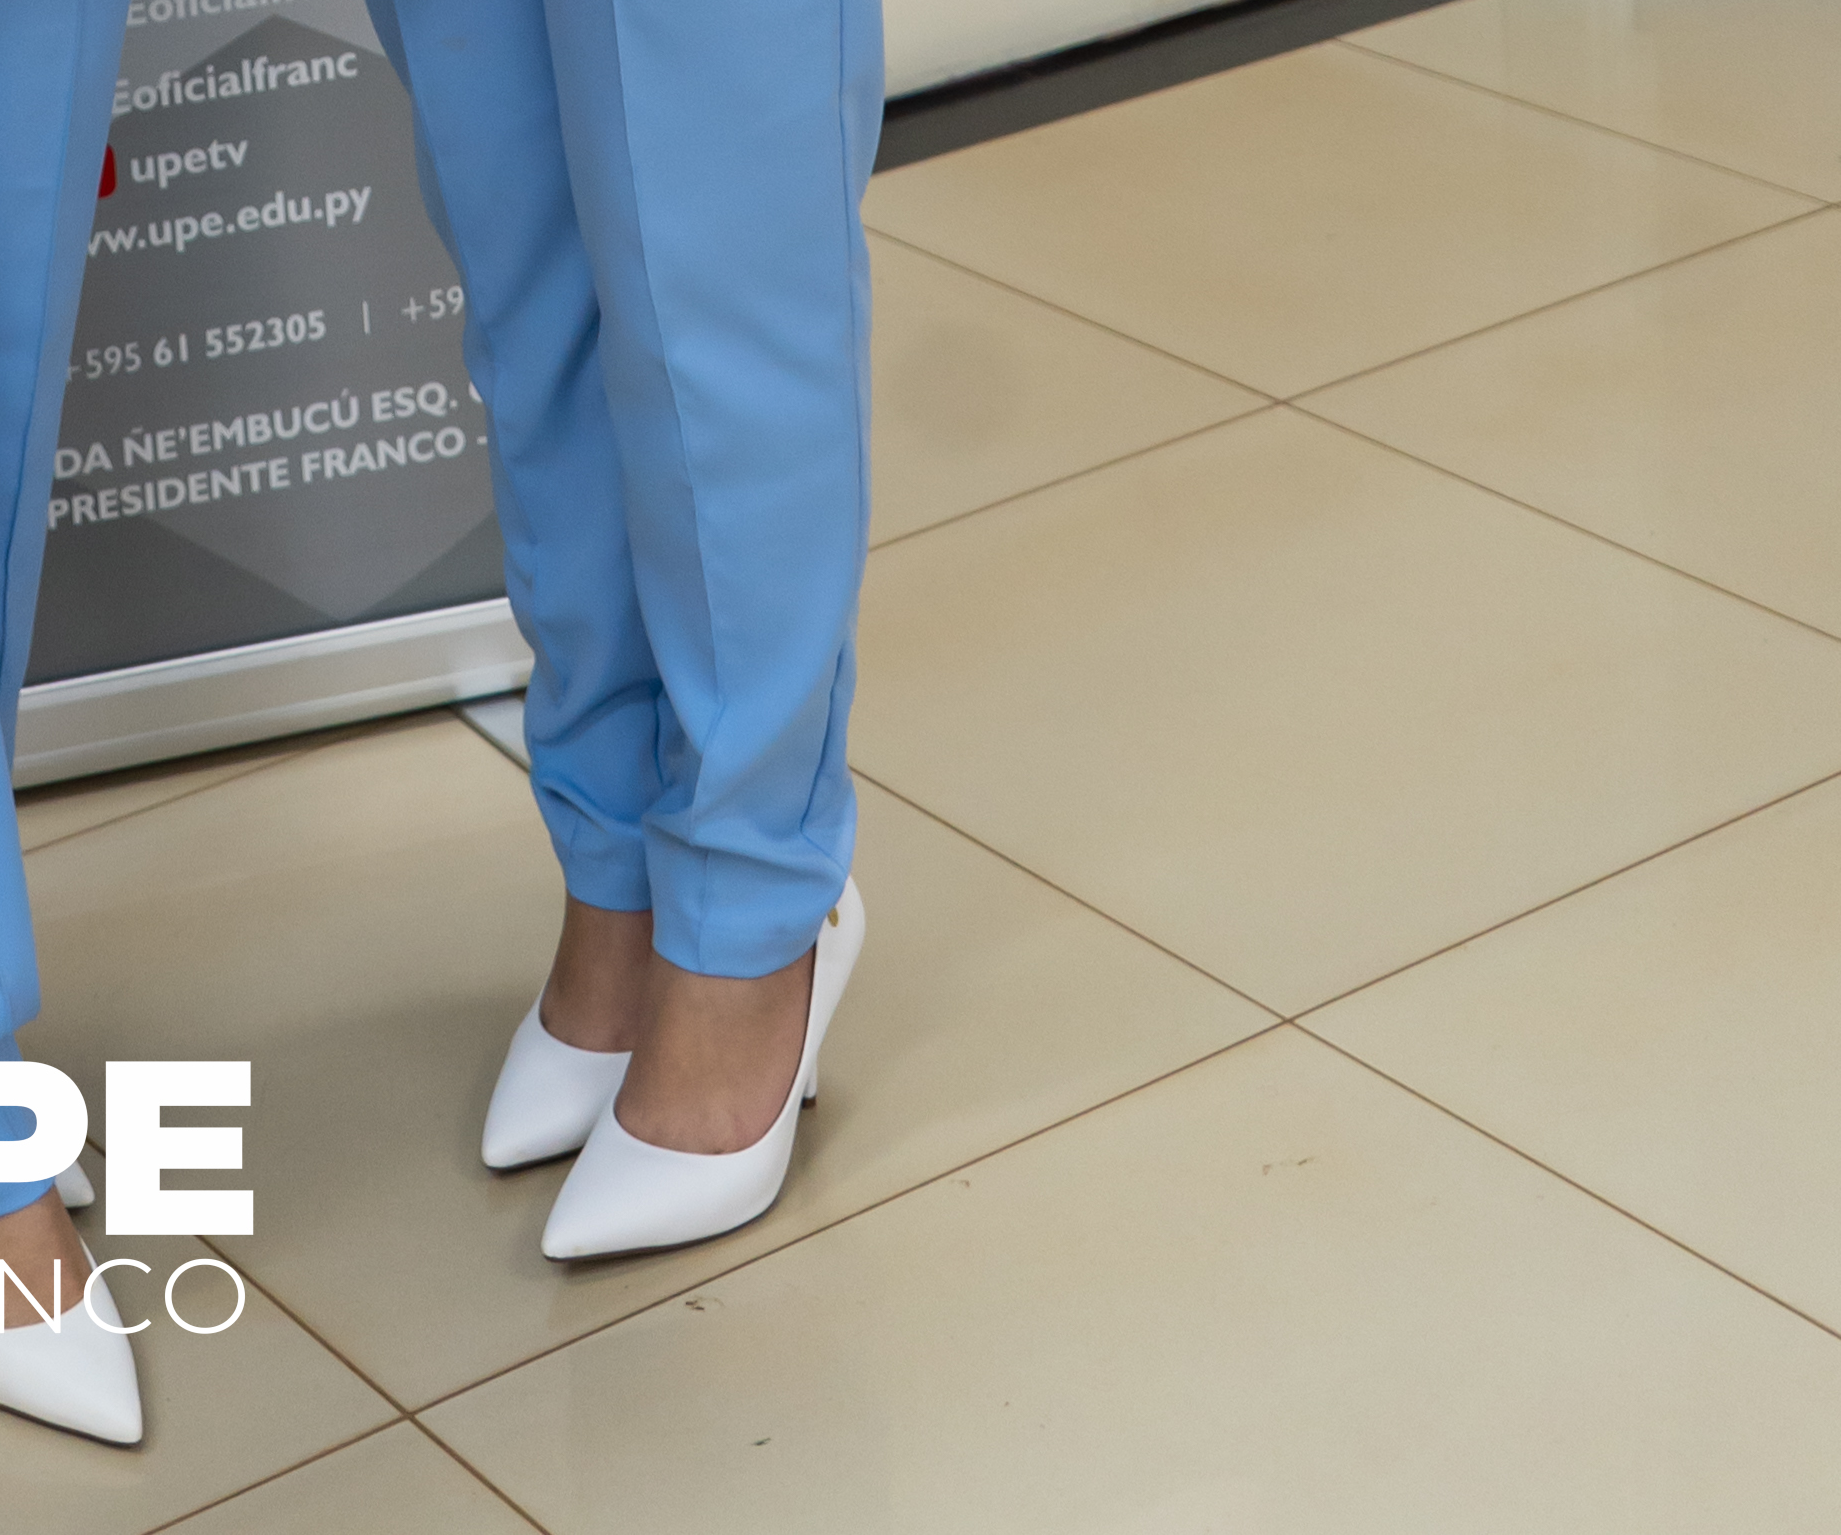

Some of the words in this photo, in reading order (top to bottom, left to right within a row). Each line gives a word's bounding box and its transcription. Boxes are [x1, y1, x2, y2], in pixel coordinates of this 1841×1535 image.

[130, 139, 249, 189] upetv
[153, 333, 189, 367] 61
[205, 309, 326, 359] 552305
[371, 381, 458, 423] ESQ.
[47, 457, 291, 530] PRESIDENTE
[301, 425, 467, 483] FRANCO
